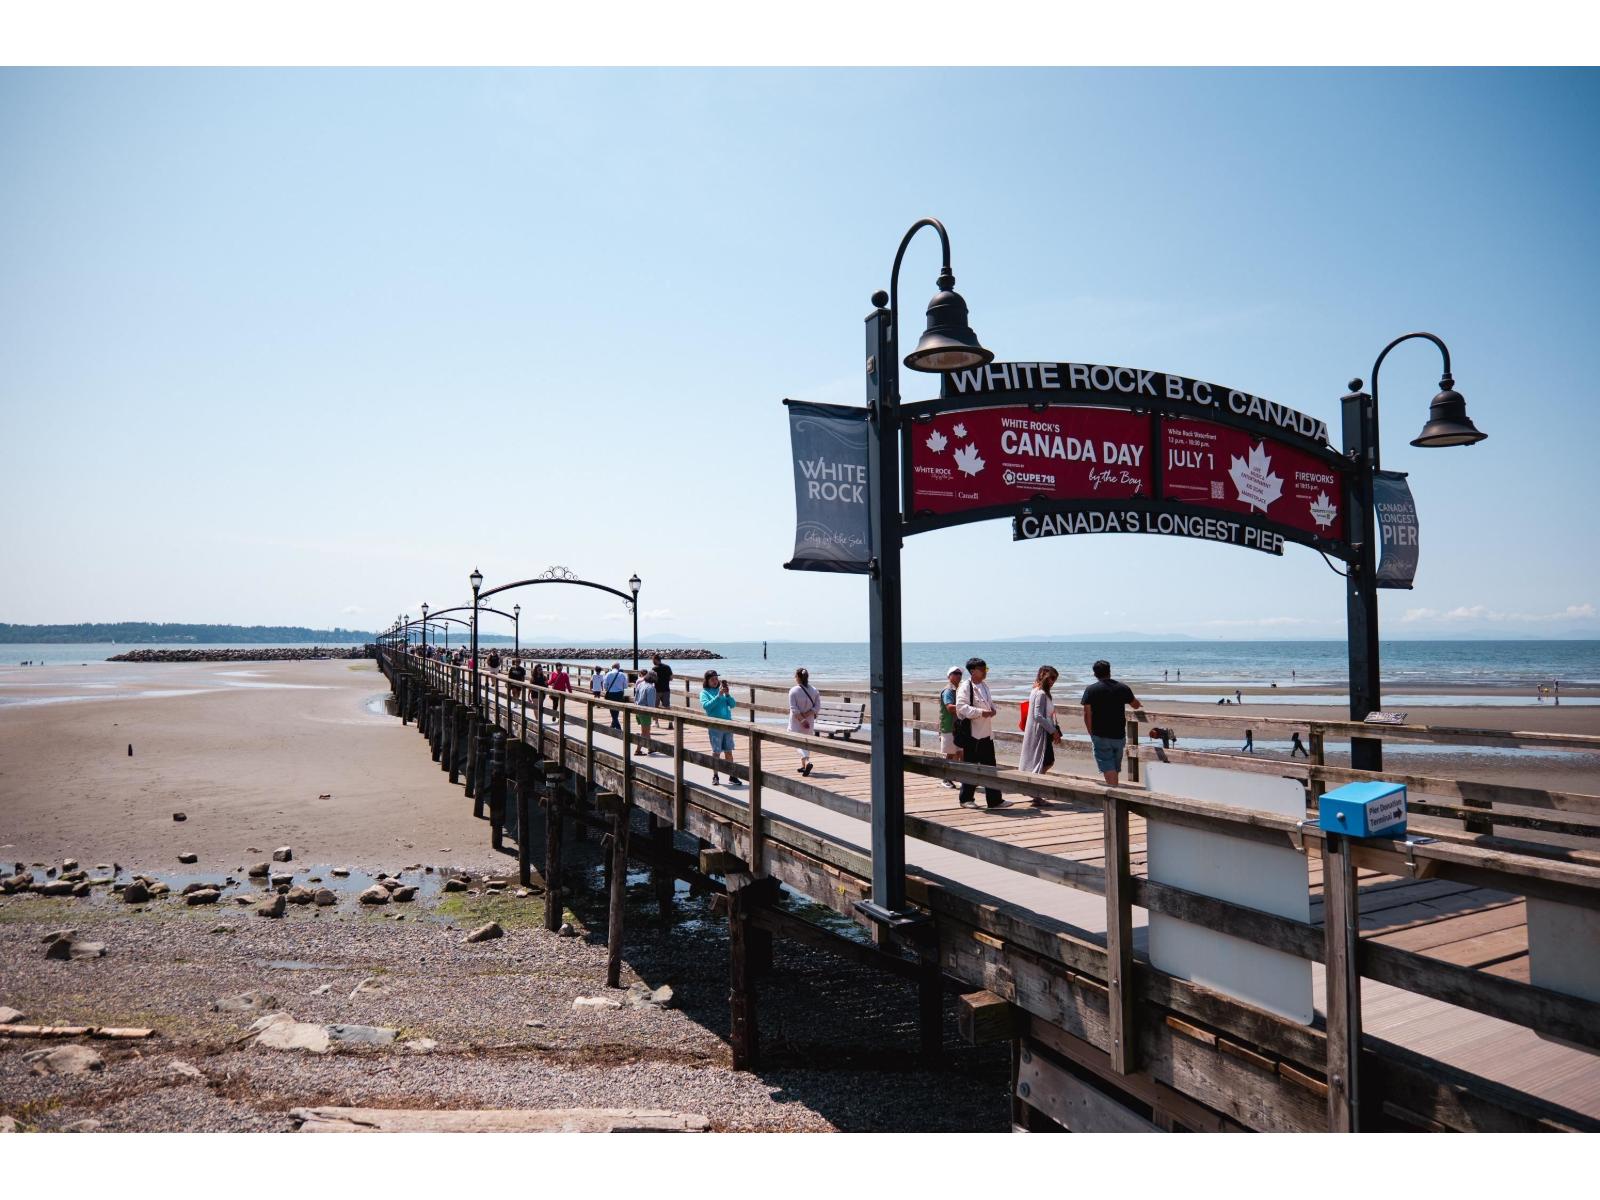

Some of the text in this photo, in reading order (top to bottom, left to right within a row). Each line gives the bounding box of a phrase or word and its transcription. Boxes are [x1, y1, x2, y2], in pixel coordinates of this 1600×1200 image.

[951, 363, 1330, 445] WHITE ROCK B.C. CANADA
[1001, 418, 1060, 433] WHITE ROCK'S
[1001, 430, 1144, 467] CANADA DAY
[914, 465, 934, 473] WHITE
[1168, 448, 1214, 471] JULY 1
[799, 457, 866, 484] WHITE
[1016, 472, 1055, 484] CUPE 718
[1088, 466, 1143, 494] by the Bay
[1295, 471, 1334, 484] FIREWORKS
[808, 481, 864, 504] ROCK
[1377, 503, 1414, 513] CANADA'S
[1380, 513, 1416, 524] LONGEST
[1022, 511, 1285, 553] CANADA'S LONGEST PIER
[1382, 524, 1417, 546] PIER
[1369, 799, 1402, 816] Pier Donation
[1370, 812, 1393, 827] Terminal
